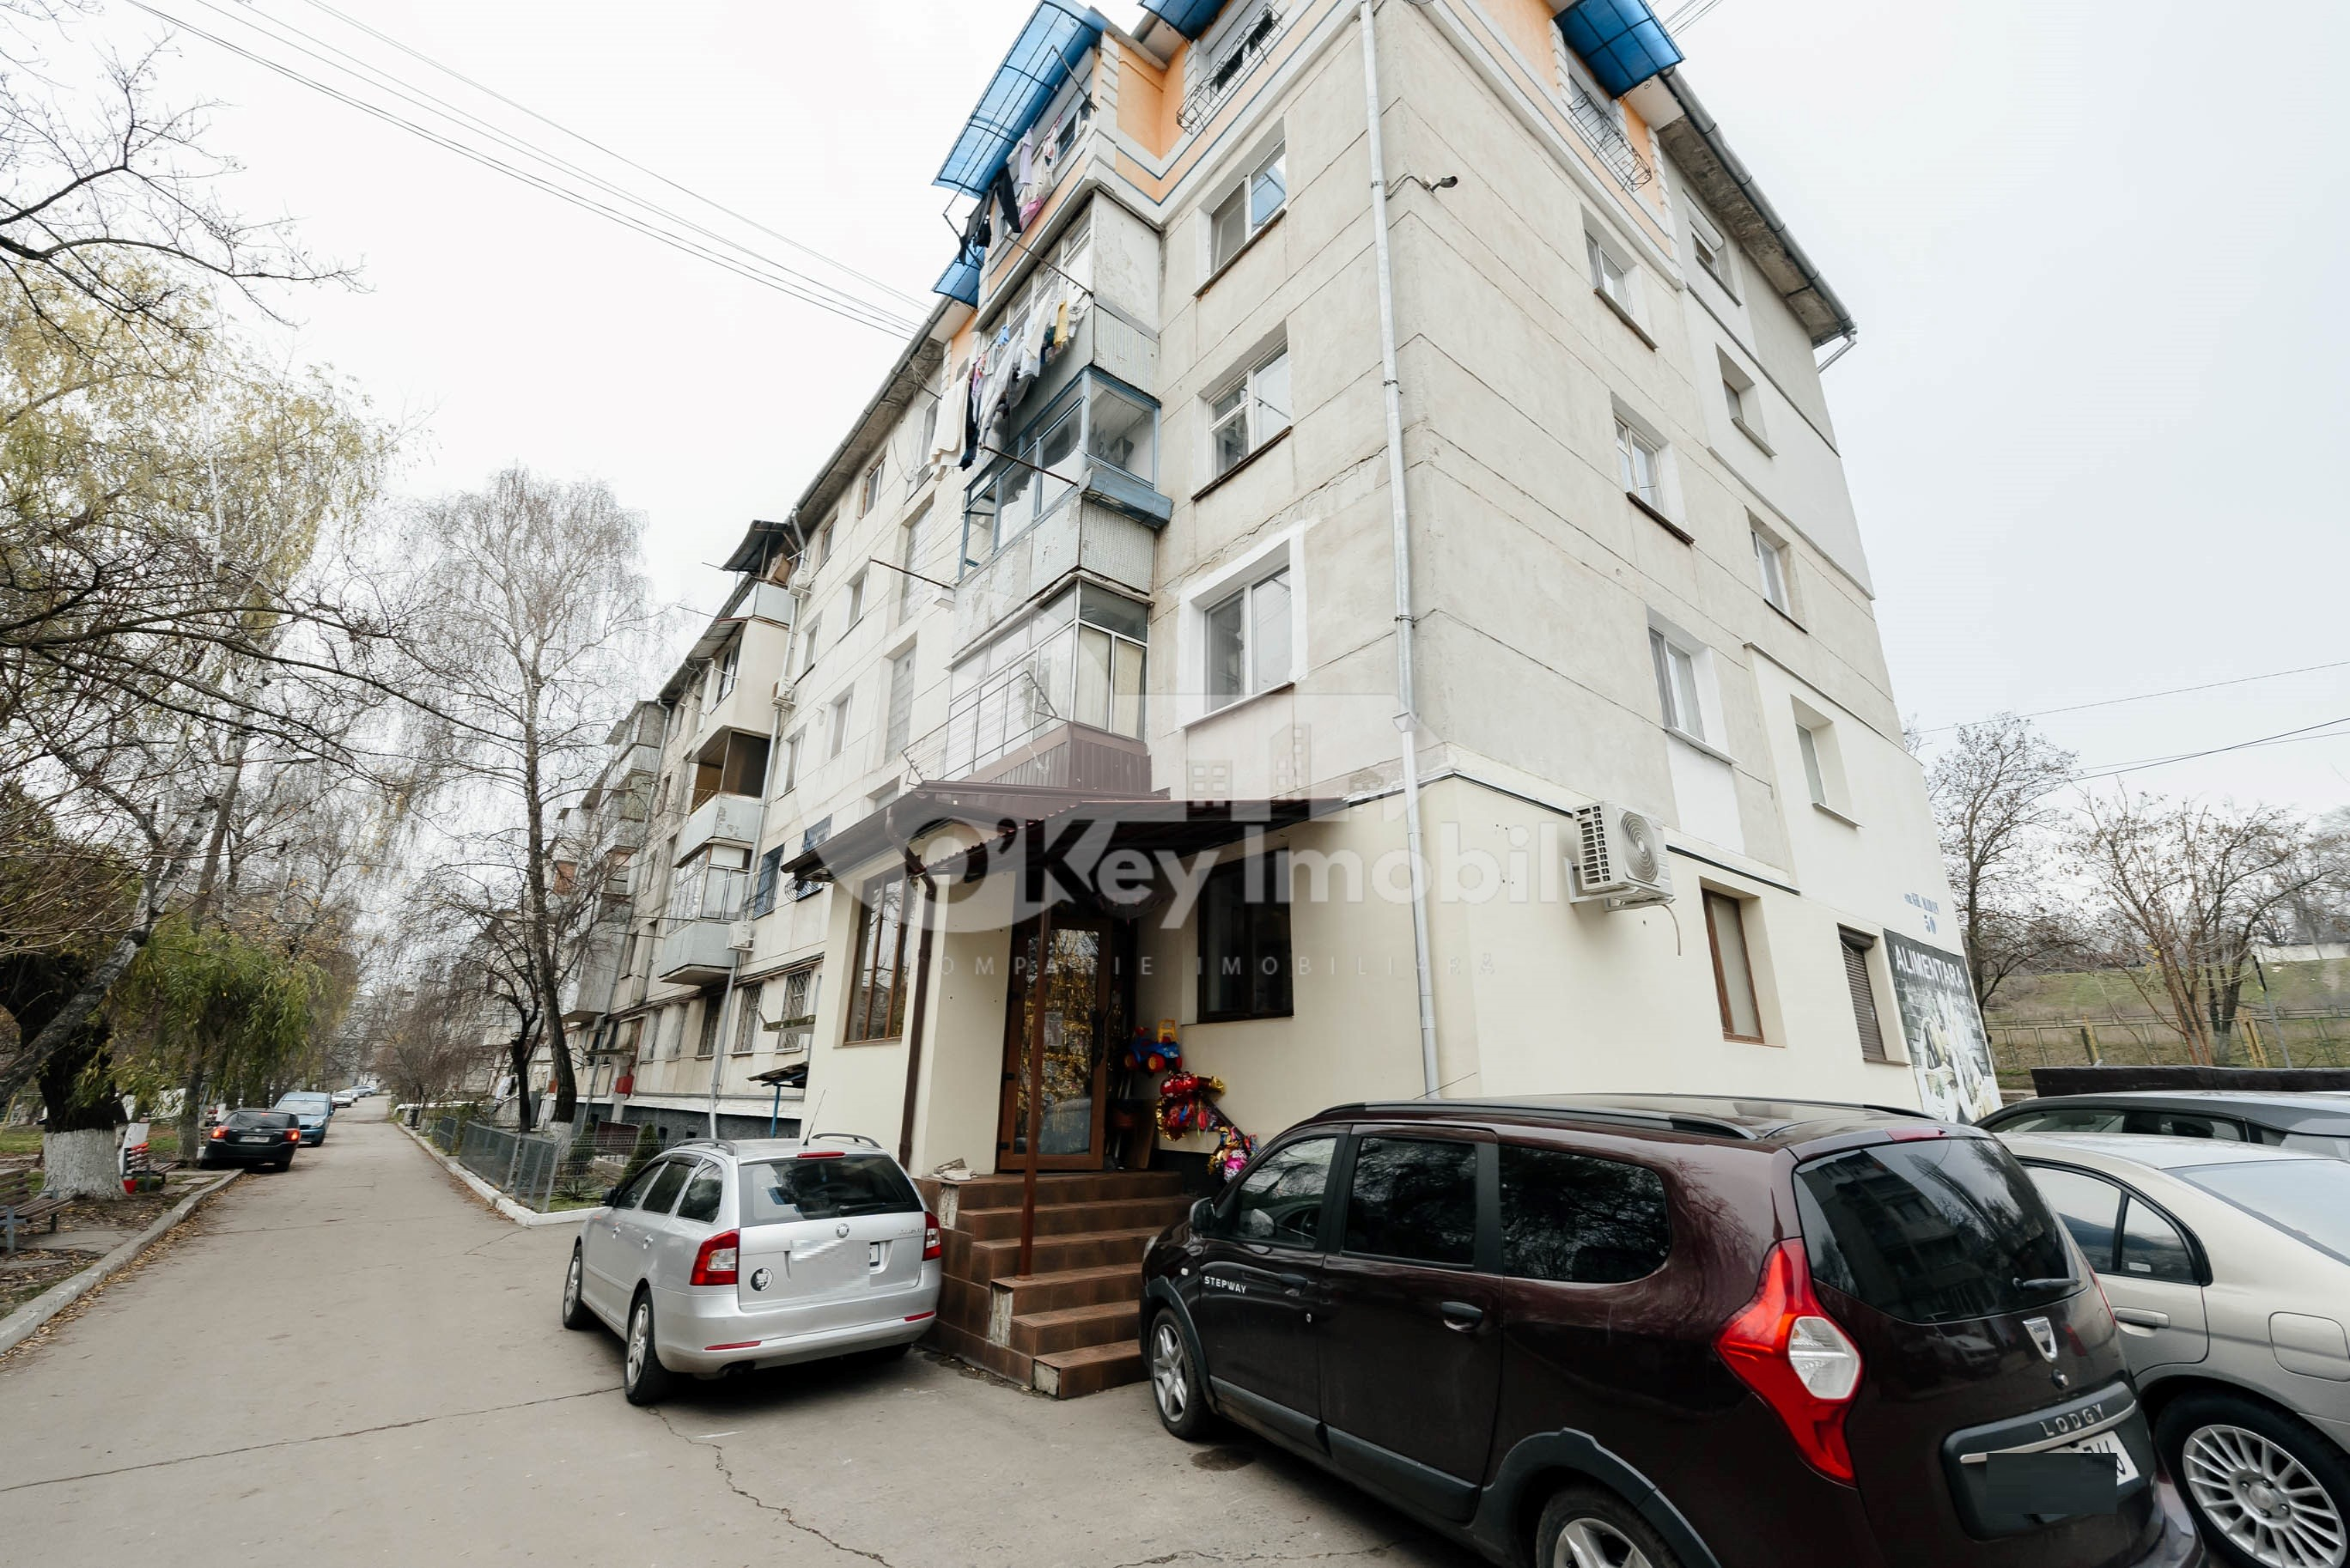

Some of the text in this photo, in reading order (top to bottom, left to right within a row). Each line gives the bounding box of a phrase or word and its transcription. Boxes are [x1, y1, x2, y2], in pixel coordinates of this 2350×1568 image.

[1895, 945, 1966, 989] ALIMENTARA
[1204, 1275, 1246, 1294] STEPWAY
[2039, 1403, 2104, 1437] LODGY
